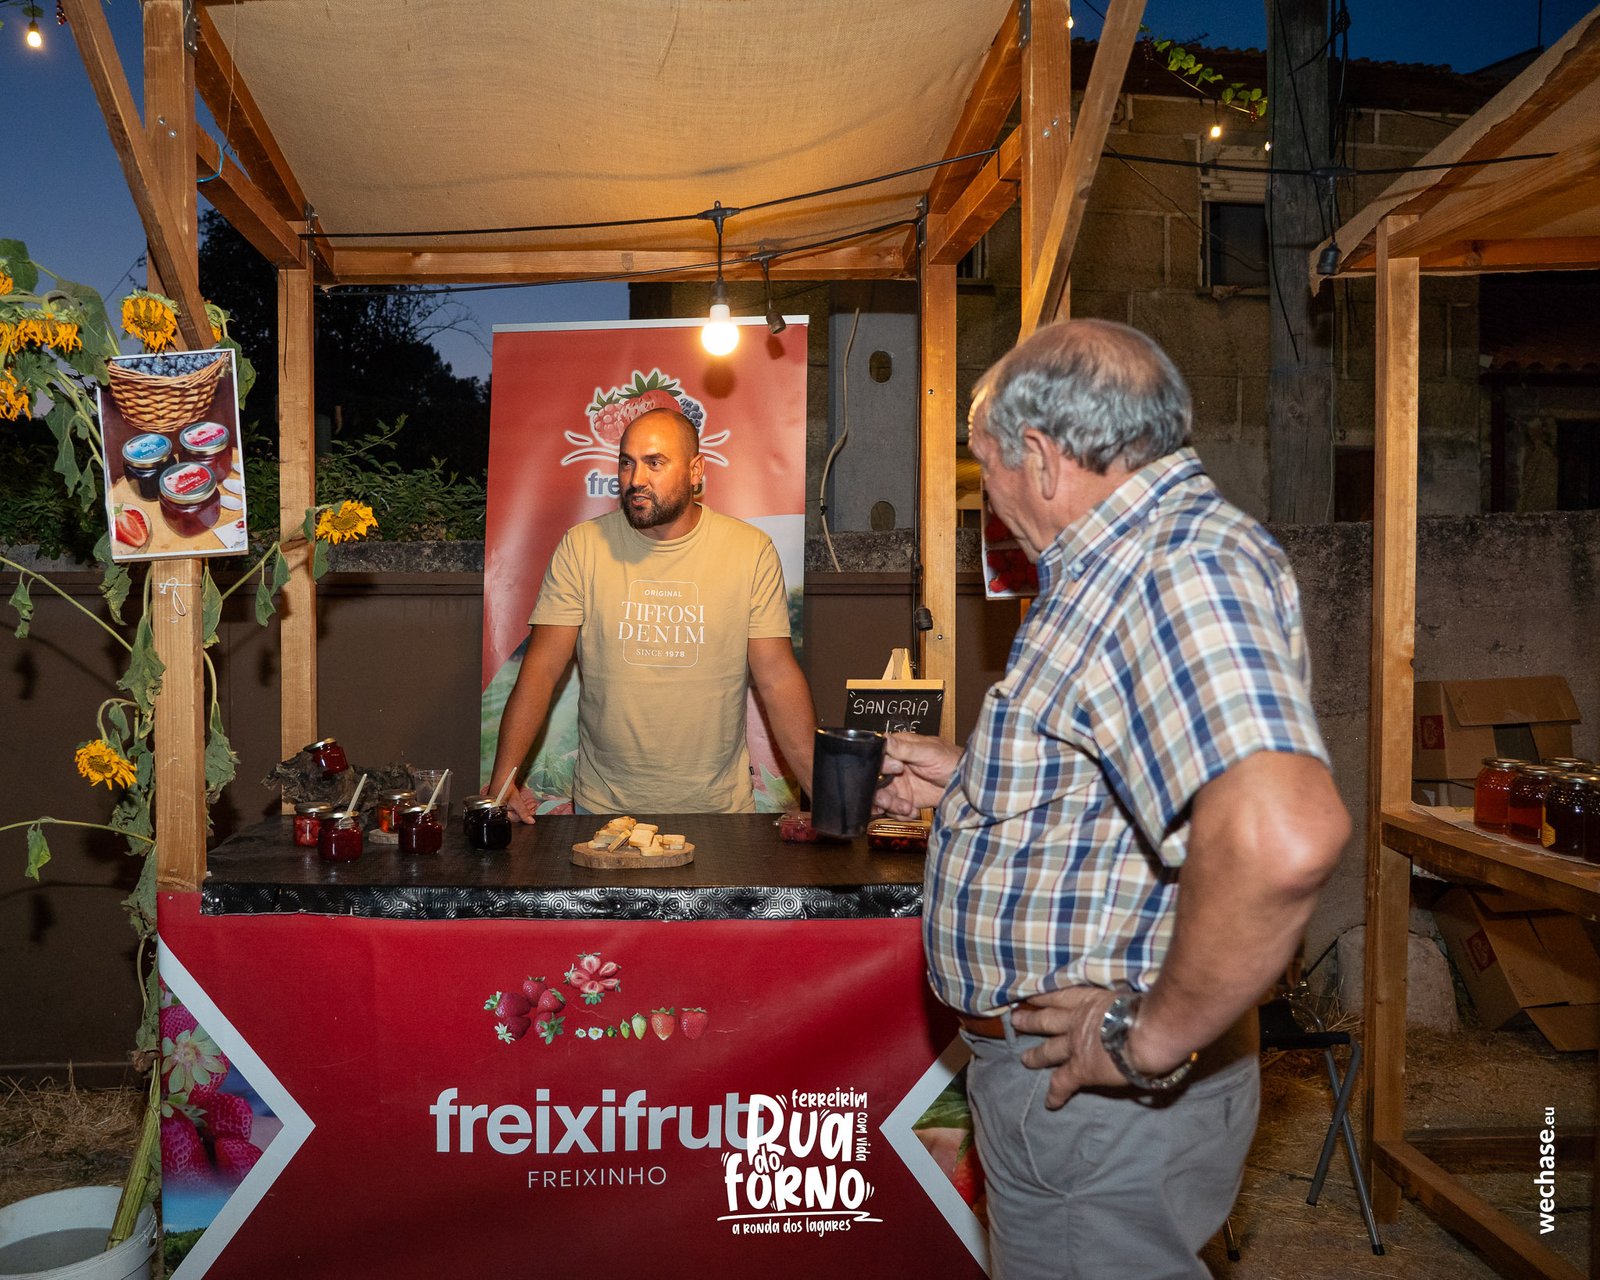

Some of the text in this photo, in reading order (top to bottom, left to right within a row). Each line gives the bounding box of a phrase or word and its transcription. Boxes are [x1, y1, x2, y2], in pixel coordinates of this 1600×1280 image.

[644, 589, 683, 598] ORIGINAL
[621, 601, 705, 624] TIFFOSI
[617, 621, 705, 644] DENIM
[636, 648, 685, 658] SINCE 1978
[528, 1166, 667, 1189] FREIXINHO
